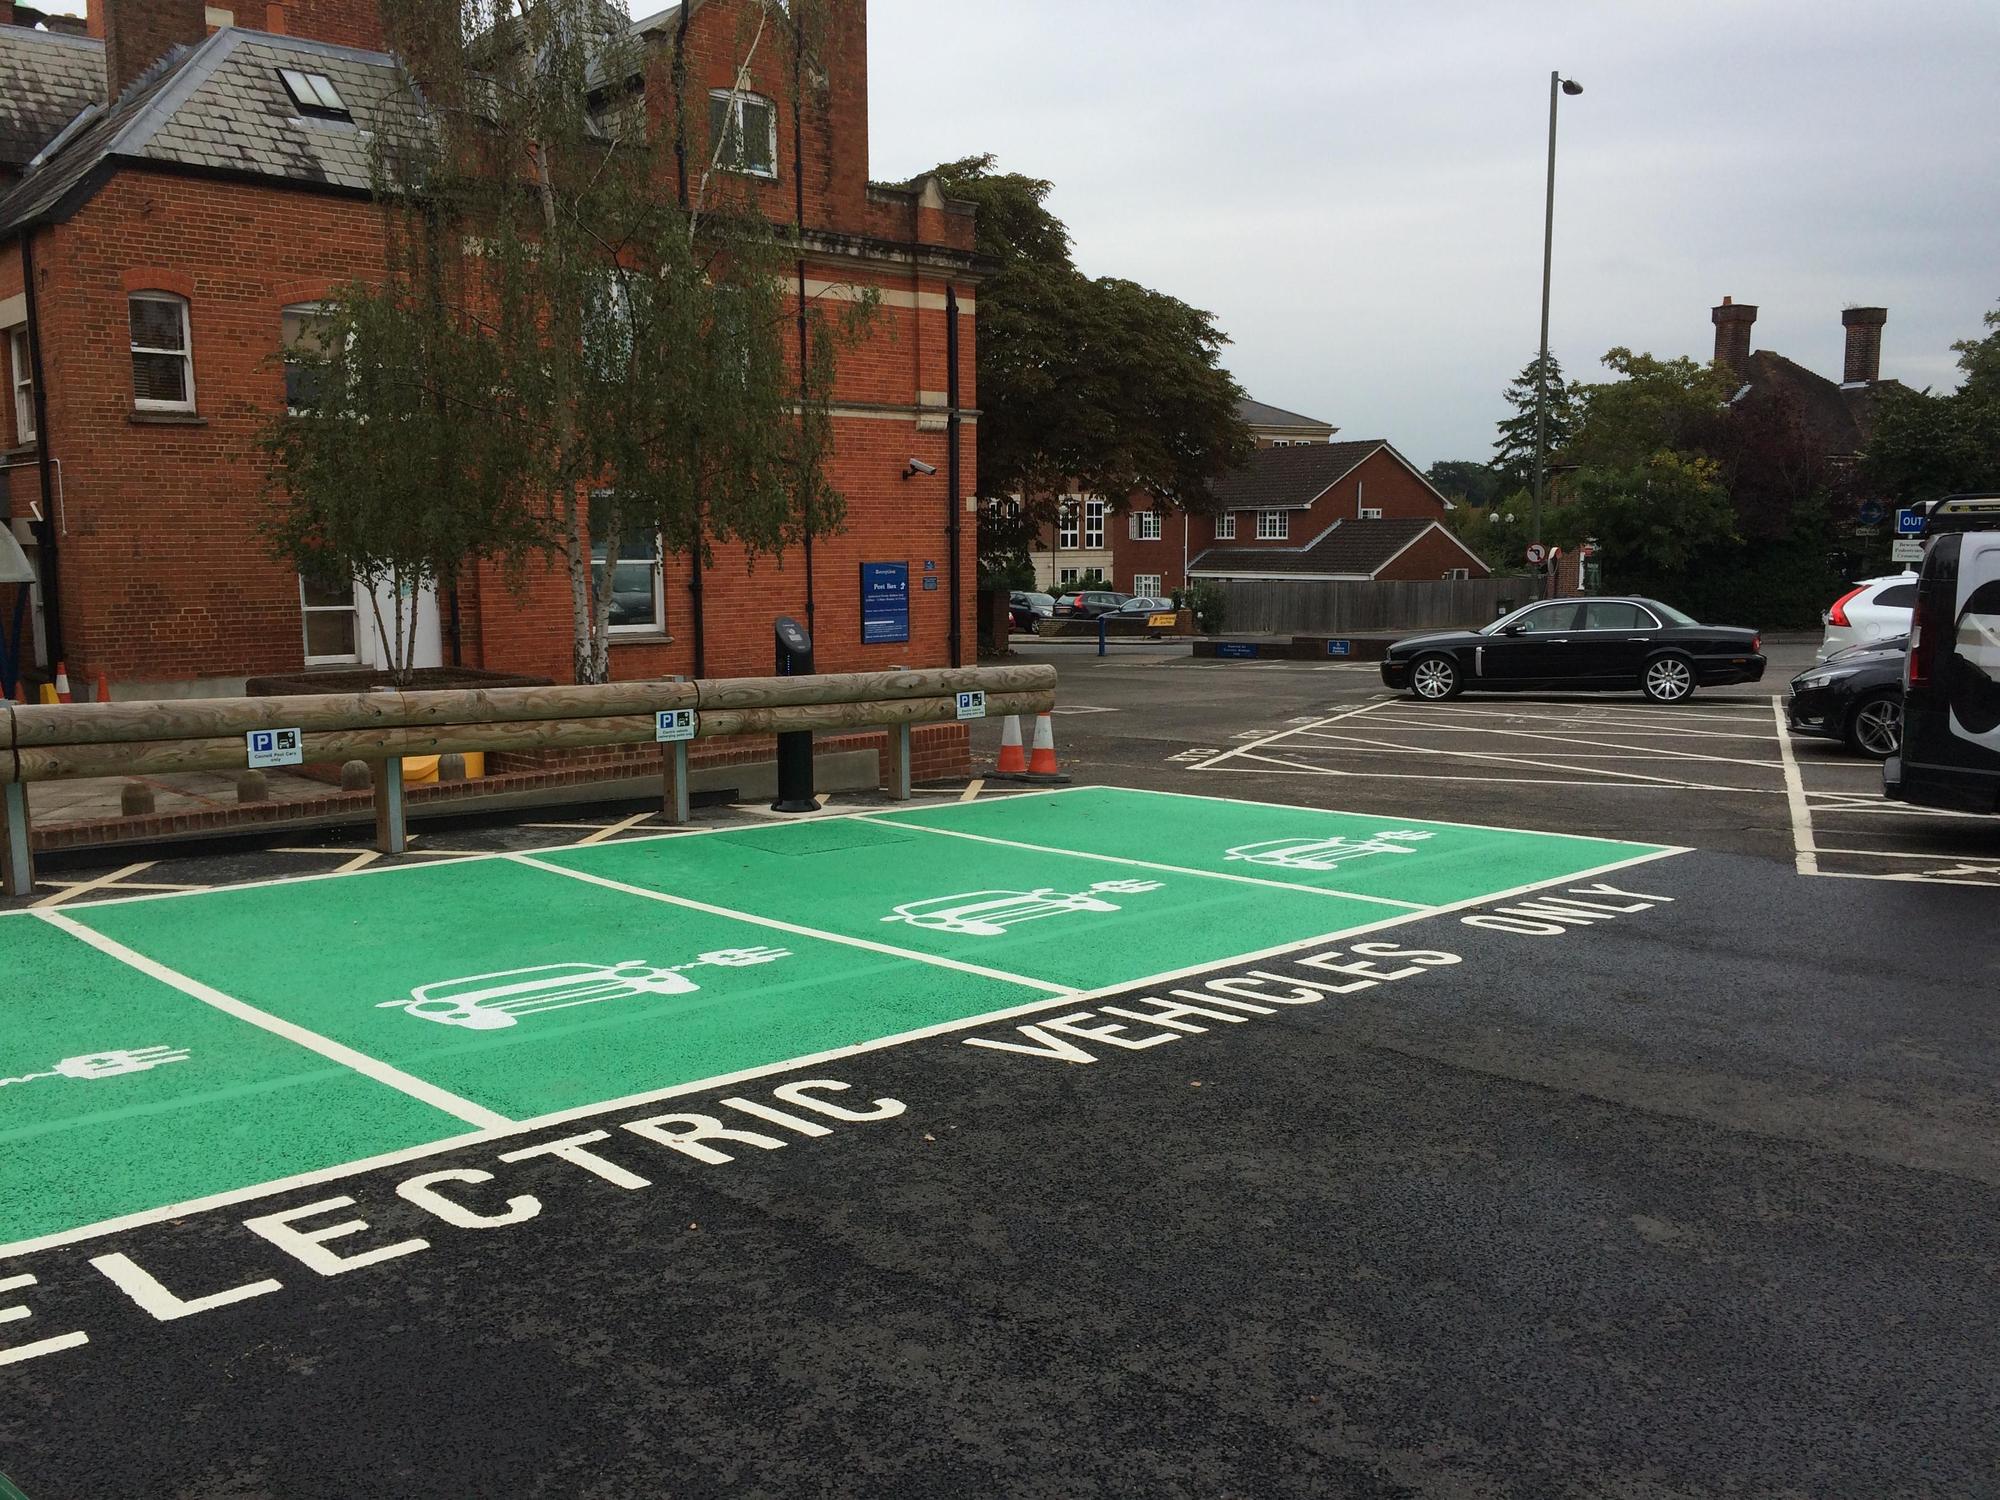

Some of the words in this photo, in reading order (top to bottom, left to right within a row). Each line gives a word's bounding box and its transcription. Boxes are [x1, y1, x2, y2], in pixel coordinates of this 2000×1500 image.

[1903, 517, 1923, 525] OUT
[663, 714, 671, 728] P
[257, 734, 269, 750] P
[961, 942, 1462, 1063] VEHICLES
[1461, 883, 1675, 935] ONLY
